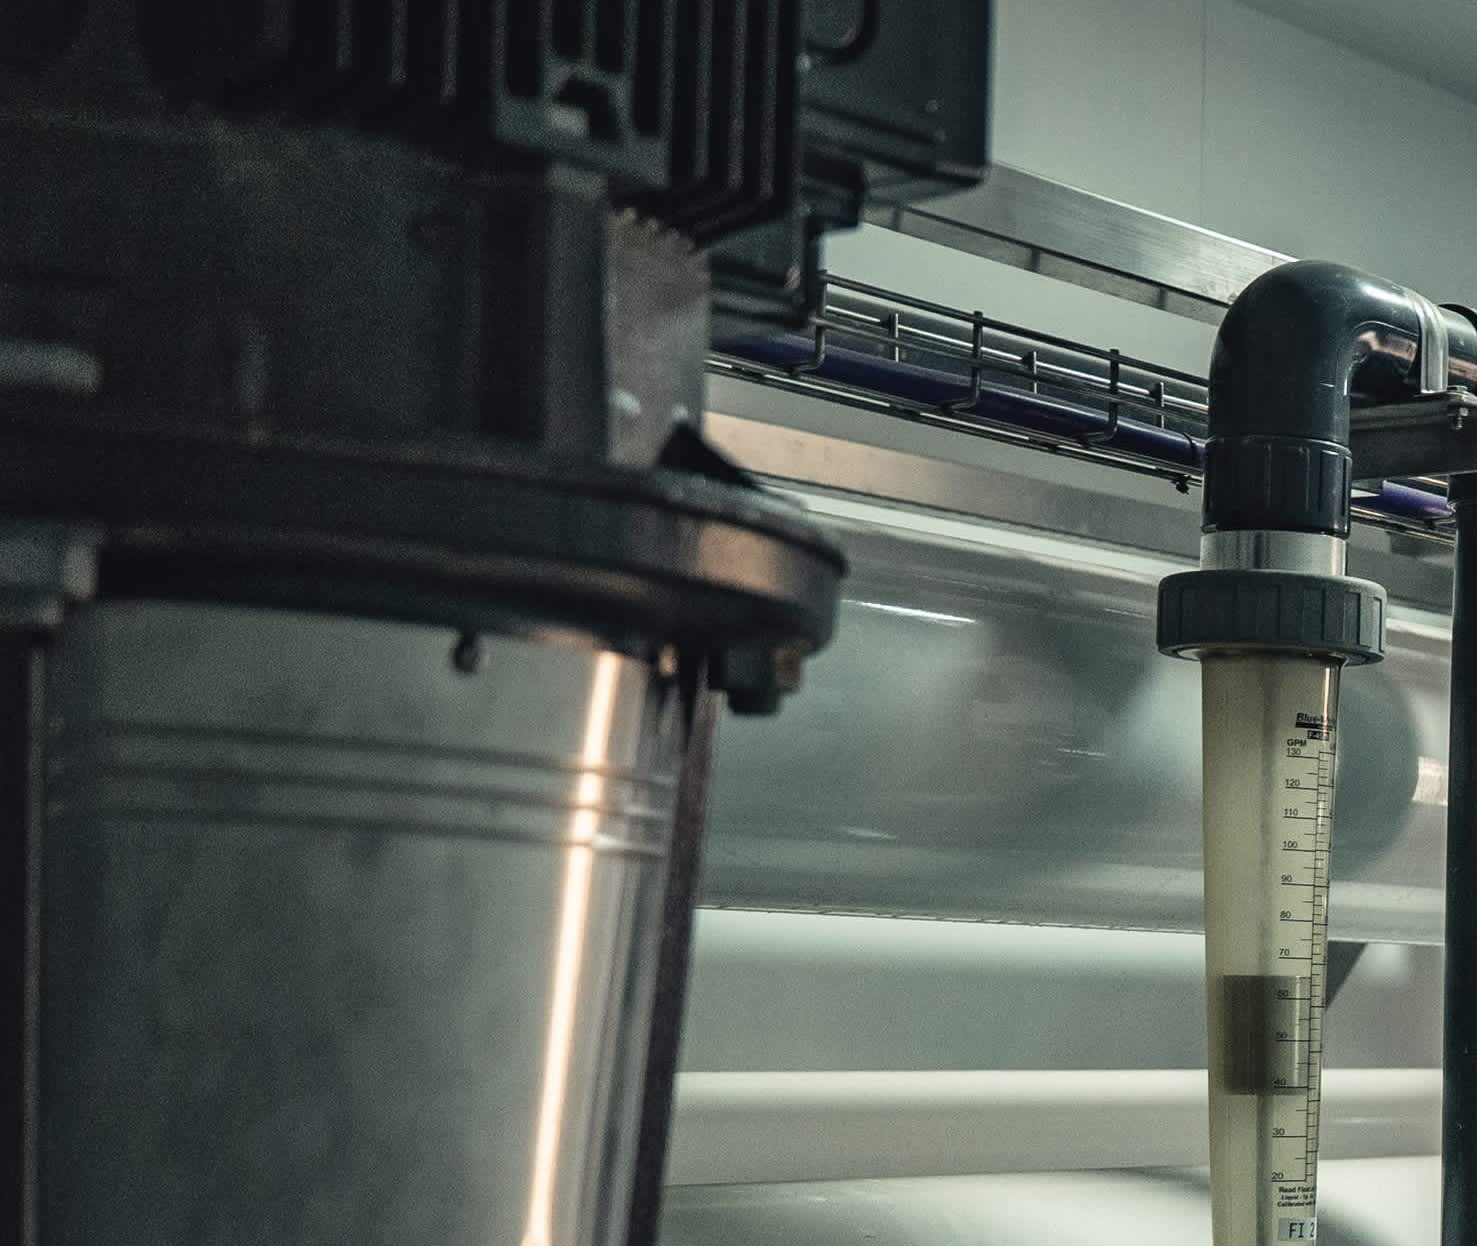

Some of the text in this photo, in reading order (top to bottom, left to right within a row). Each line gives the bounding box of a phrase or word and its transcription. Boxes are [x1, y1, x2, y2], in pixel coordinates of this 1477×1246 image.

[1286, 738, 1307, 747] GPM
[1286, 747, 1301, 756] 130
[1285, 778, 1300, 787] 120
[1284, 807, 1298, 816] 110
[1282, 841, 1298, 849] 100
[1281, 874, 1292, 883] 90
[1280, 910, 1292, 919] 80
[1279, 948, 1290, 956] 70
[1272, 1127, 1285, 1136] 30
[1271, 1171, 1284, 1180] 20
[1289, 1222, 1305, 1238] FI
